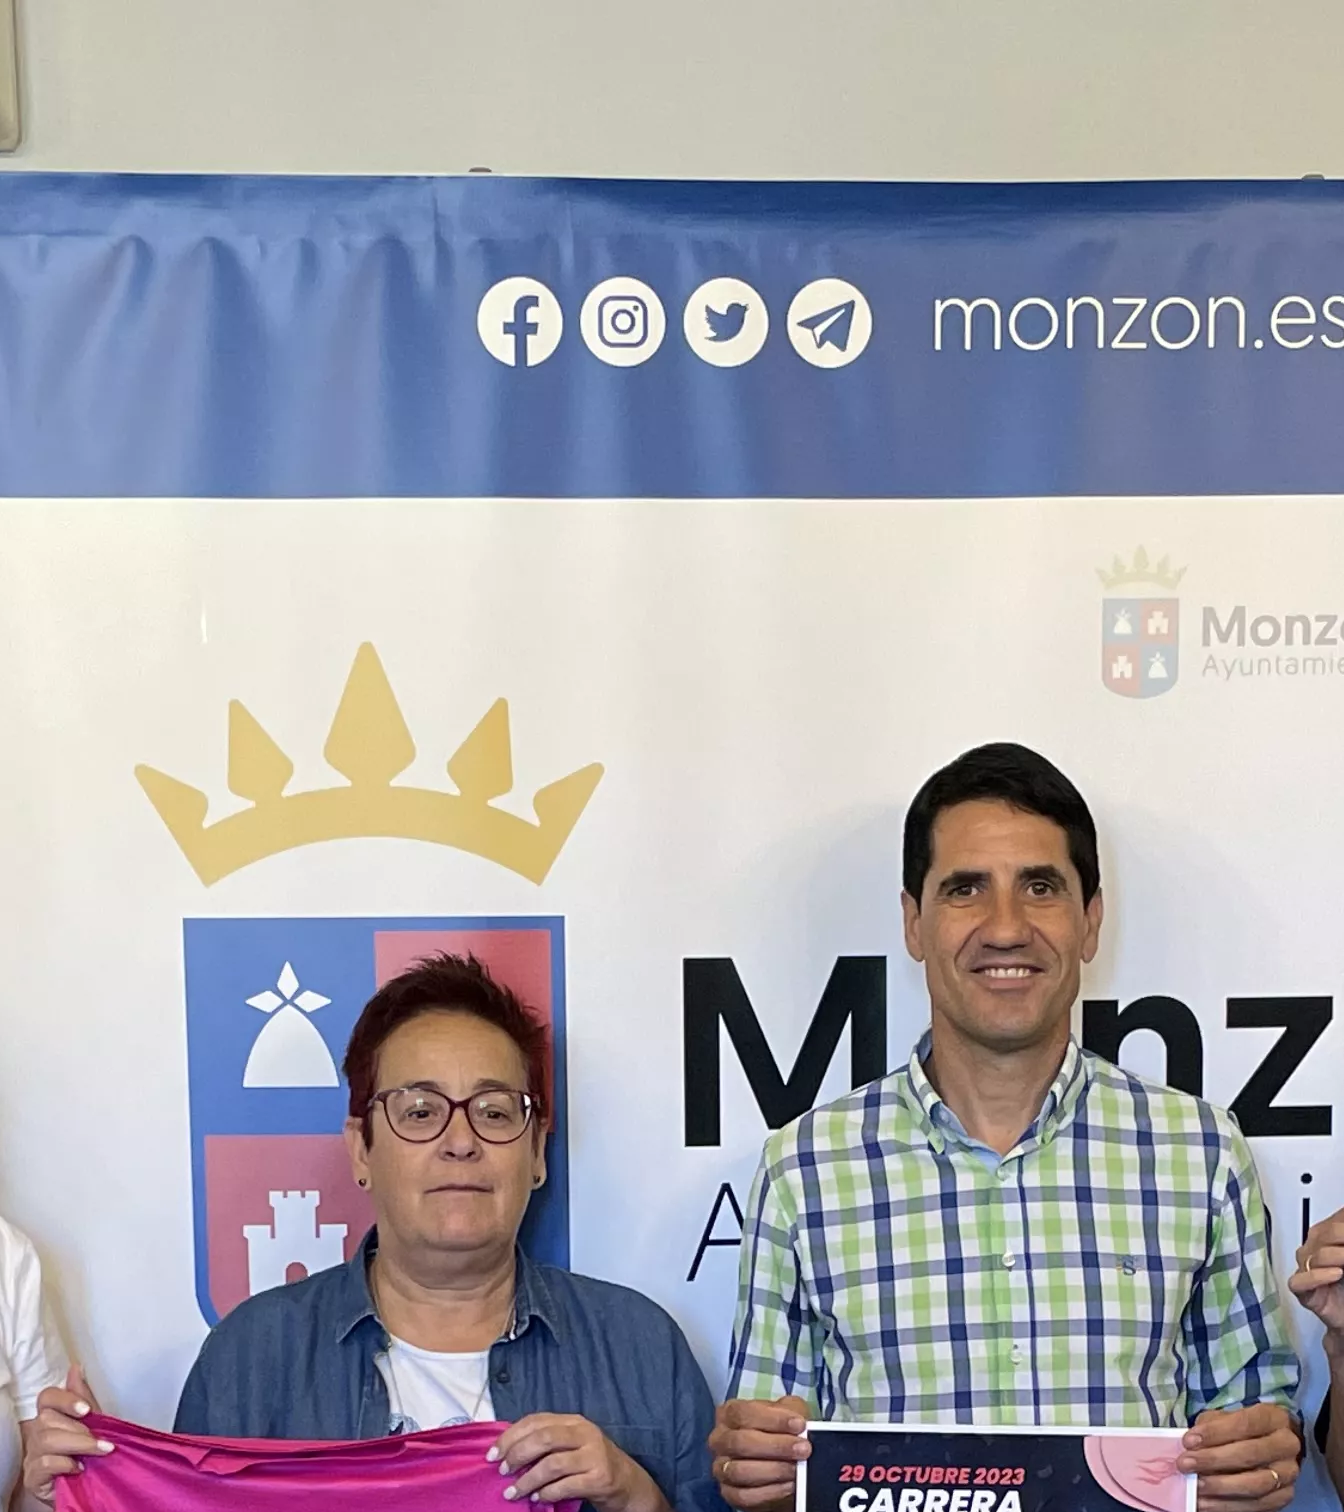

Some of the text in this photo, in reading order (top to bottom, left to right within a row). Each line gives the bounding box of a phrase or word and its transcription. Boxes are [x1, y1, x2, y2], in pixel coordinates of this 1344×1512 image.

[838, 1465, 1025, 1485] 29 OCTUBRE 2023
